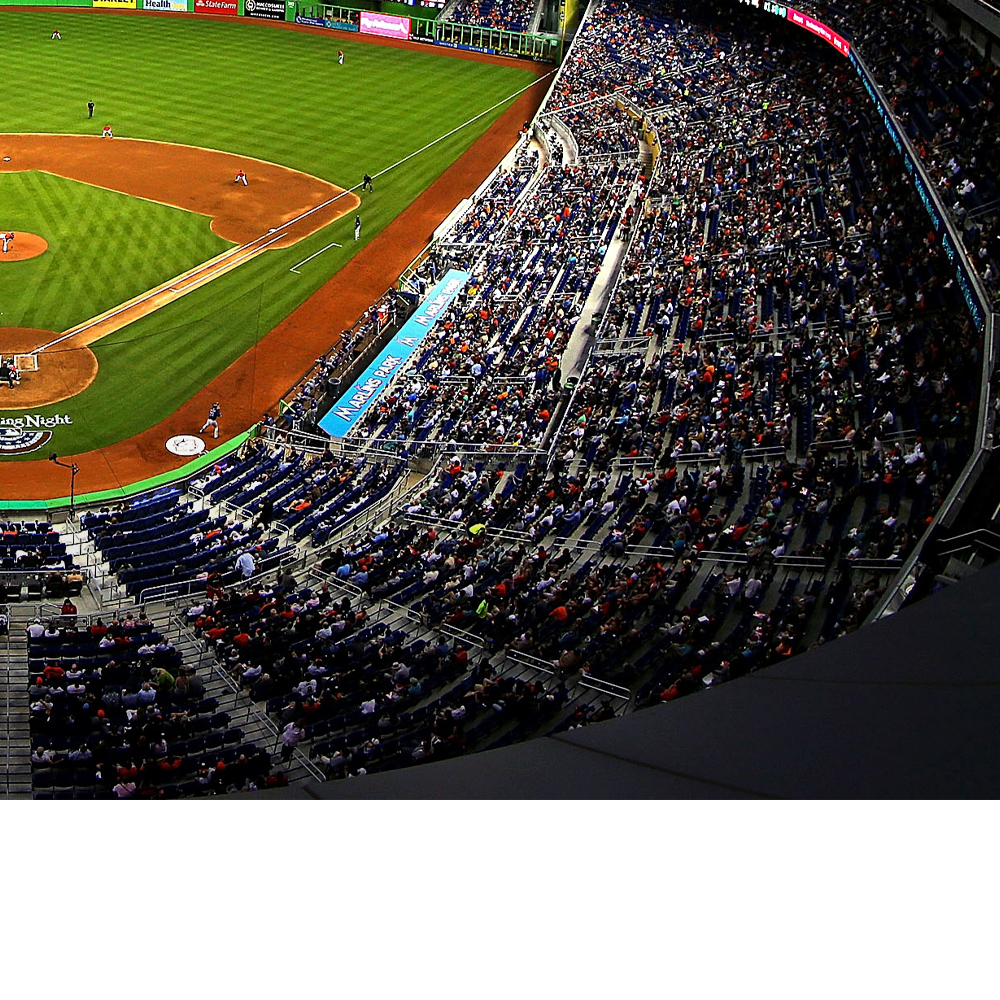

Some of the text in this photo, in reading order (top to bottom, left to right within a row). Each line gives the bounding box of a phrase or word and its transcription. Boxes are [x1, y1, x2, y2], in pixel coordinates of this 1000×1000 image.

[145, 0, 171, 8] Health
[413, 294, 449, 327] MARLINS
[333, 354, 403, 422] MARLINS PARK
[23, 413, 73, 428] Night
